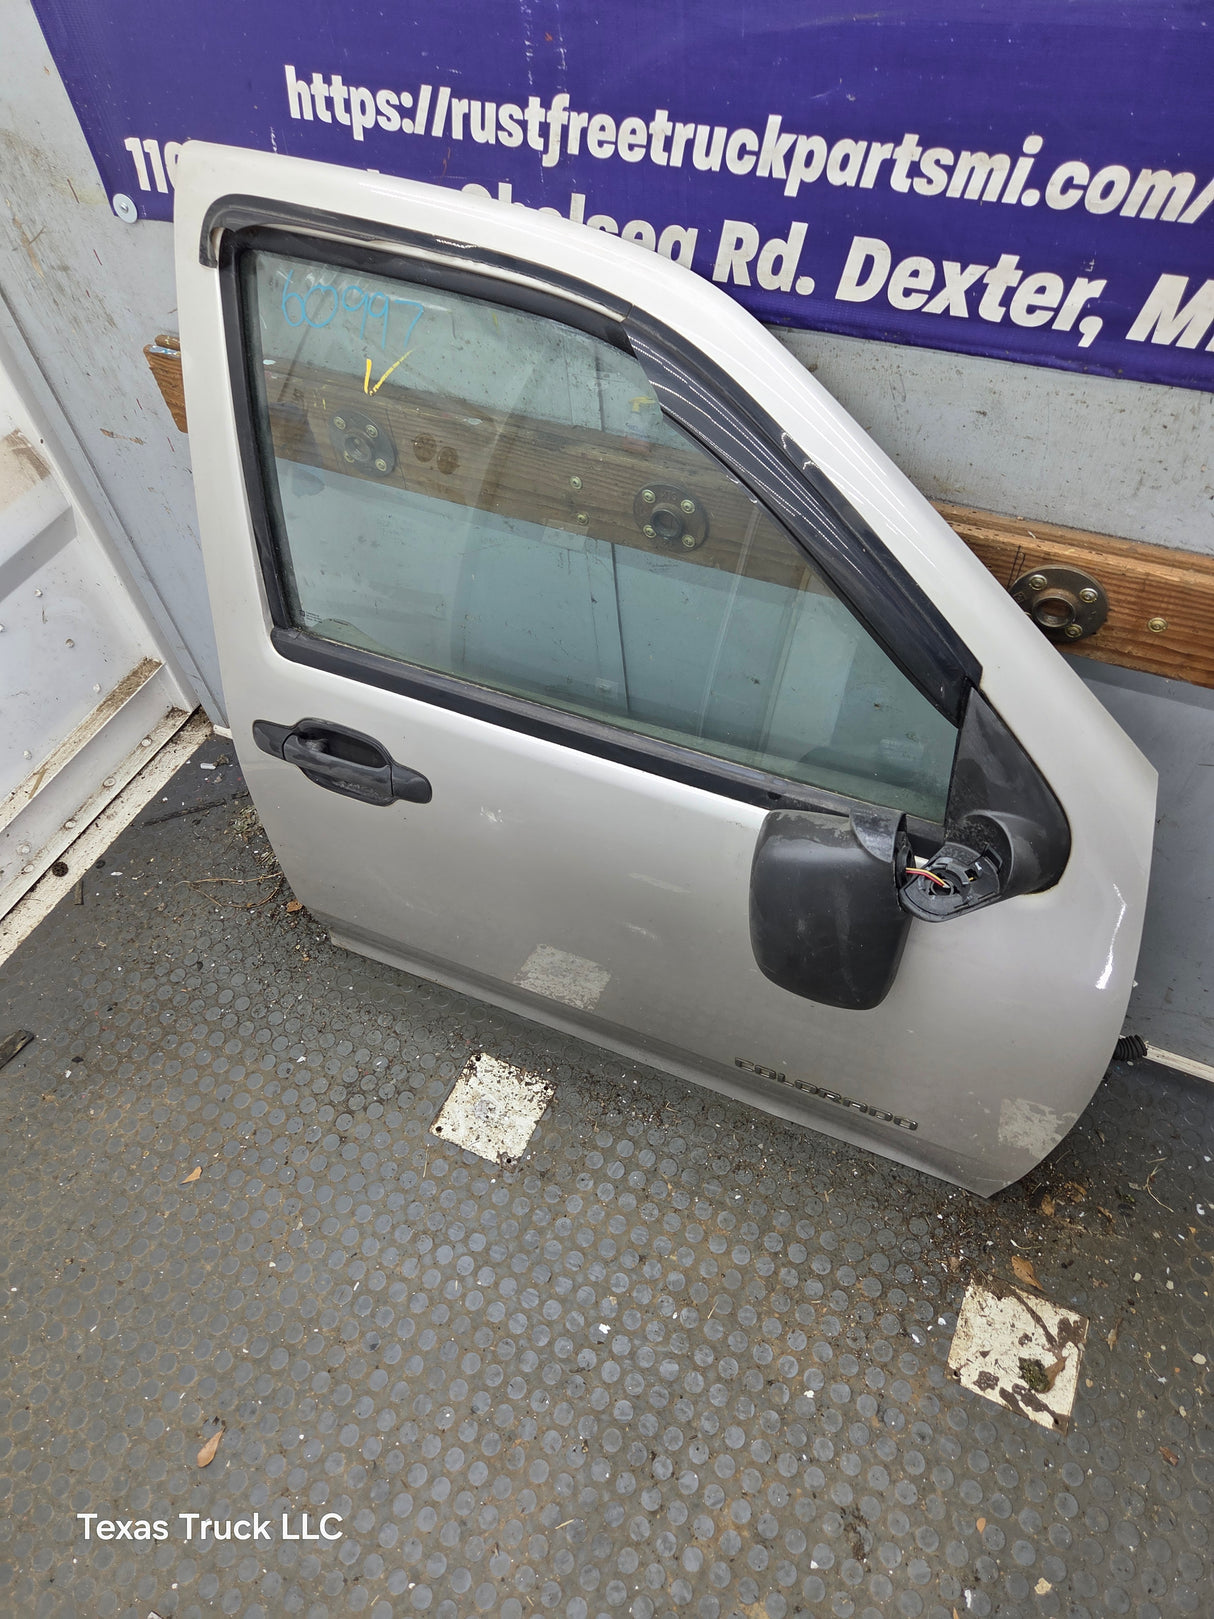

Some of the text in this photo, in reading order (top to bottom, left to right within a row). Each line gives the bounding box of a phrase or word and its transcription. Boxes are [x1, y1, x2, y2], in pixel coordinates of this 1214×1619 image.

[281, 268, 425, 350] 60997
[712, 218, 816, 296] Rd.
[834, 235, 1108, 349] Dexter,
[1125, 272, 1214, 353] M
[734, 1056, 919, 1131] COLORADO
